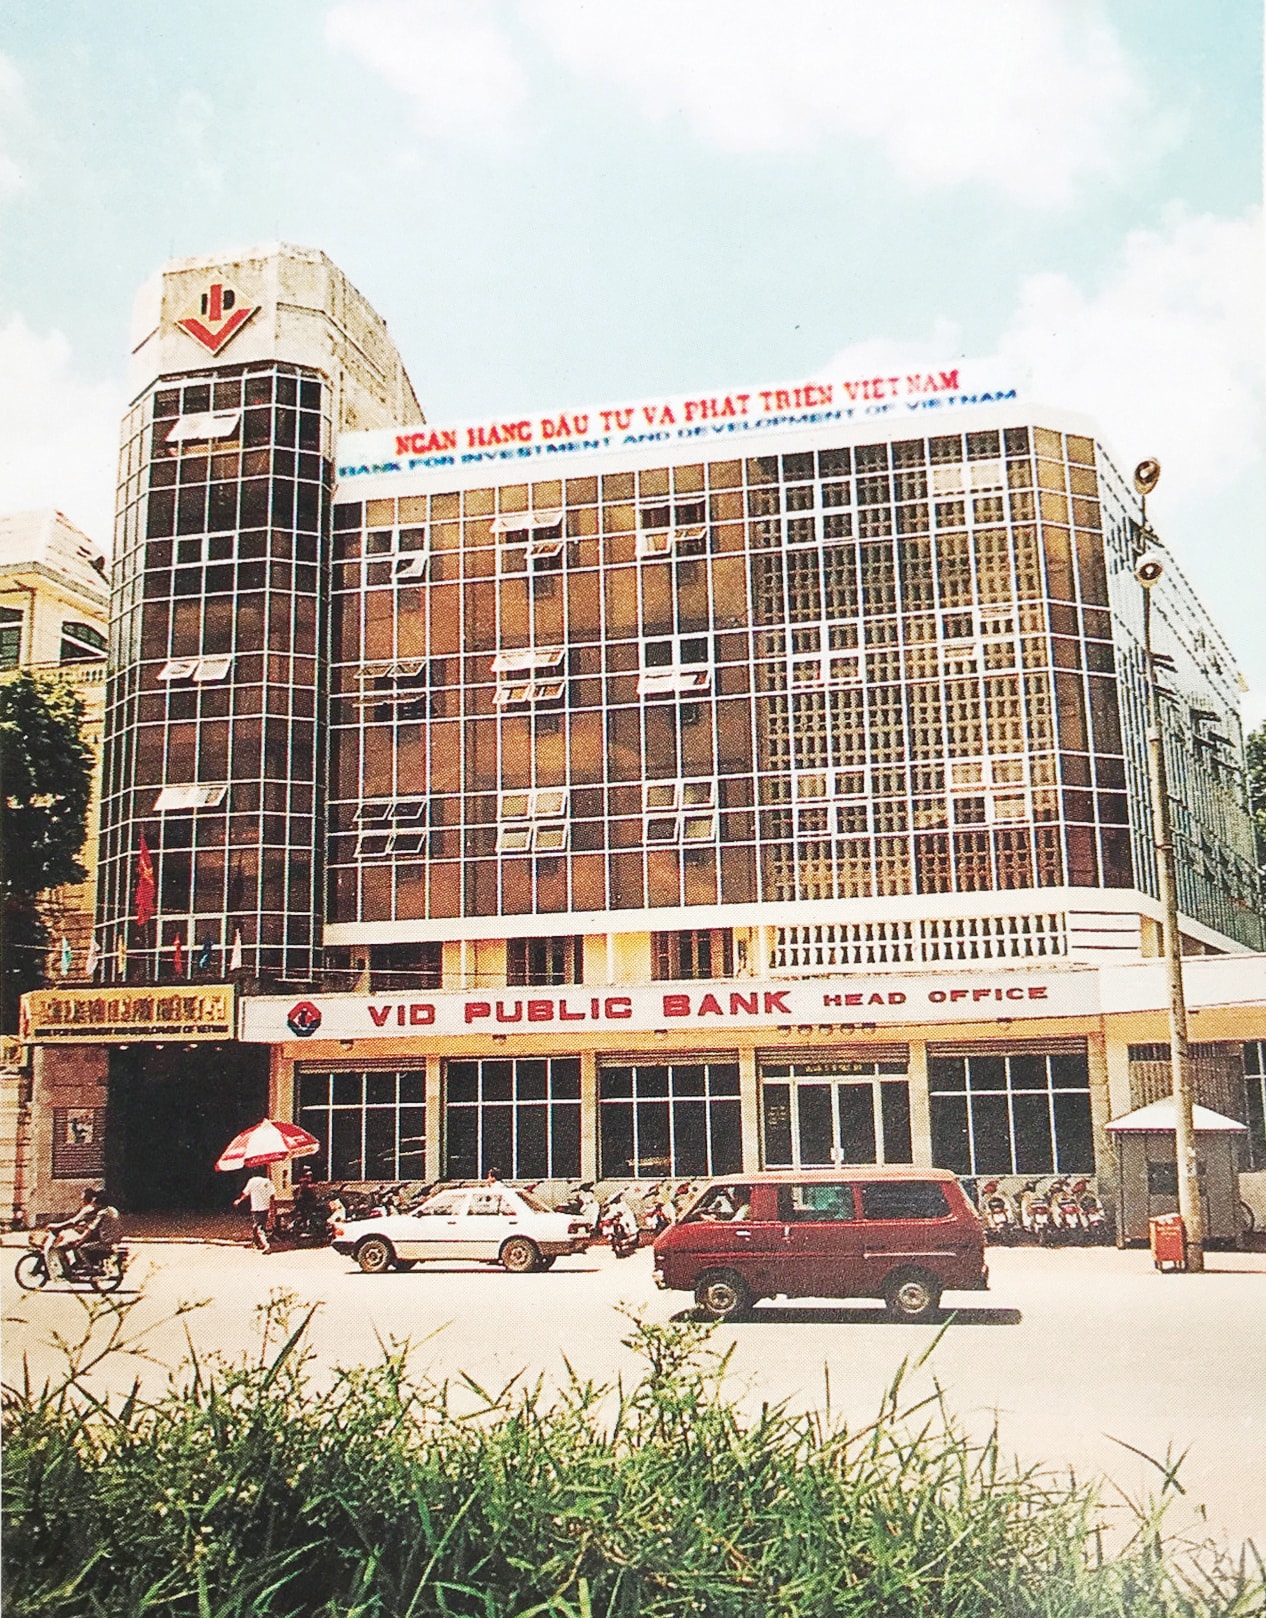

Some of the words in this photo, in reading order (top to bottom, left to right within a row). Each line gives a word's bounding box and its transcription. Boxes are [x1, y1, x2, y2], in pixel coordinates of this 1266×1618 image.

[906, 368, 960, 394] NAM
[338, 461, 401, 477] BANK
[407, 455, 455, 470] FOR
[460, 438, 611, 463] INVESTMENT
[622, 432, 671, 444] AND
[676, 408, 855, 438] DEVELOPMENT
[865, 403, 895, 415] OF
[906, 388, 1018, 411] VIETNAM
[368, 1003, 436, 1027] VID
[464, 997, 632, 1024] PUBLIC
[662, 990, 792, 1017] BANK
[823, 992, 907, 1007] HEAD
[928, 986, 1048, 1003] OFFICE
